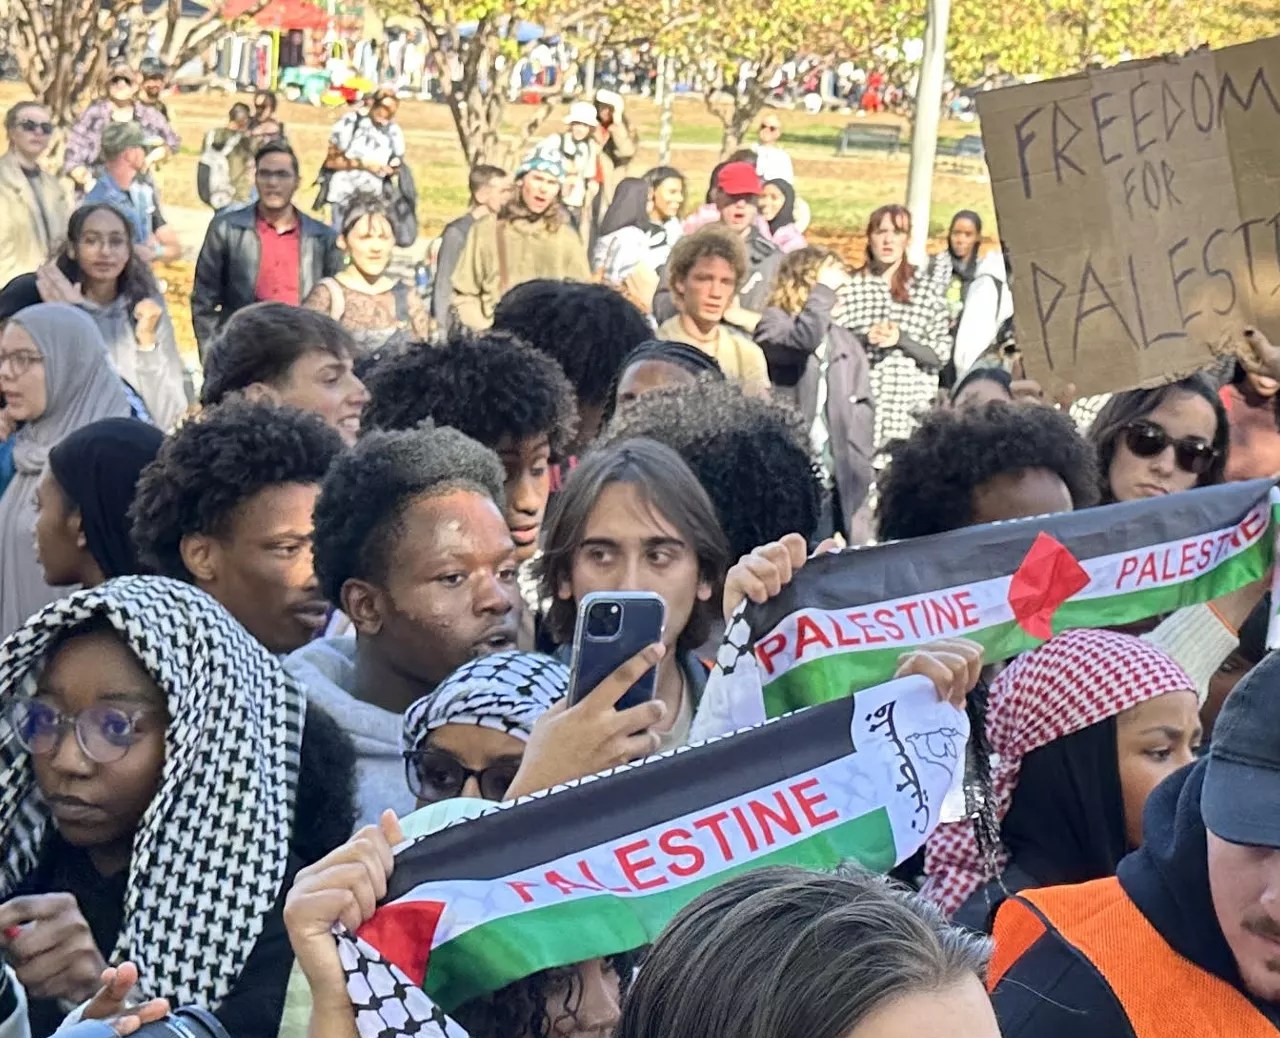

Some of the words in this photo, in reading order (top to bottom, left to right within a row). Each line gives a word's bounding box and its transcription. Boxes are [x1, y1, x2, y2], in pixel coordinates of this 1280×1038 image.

[1123, 160, 1183, 221] FOR
[754, 591, 980, 674] PALESTINE
[1116, 513, 1267, 589] PALESTE
[865, 700, 930, 834] فلسطين
